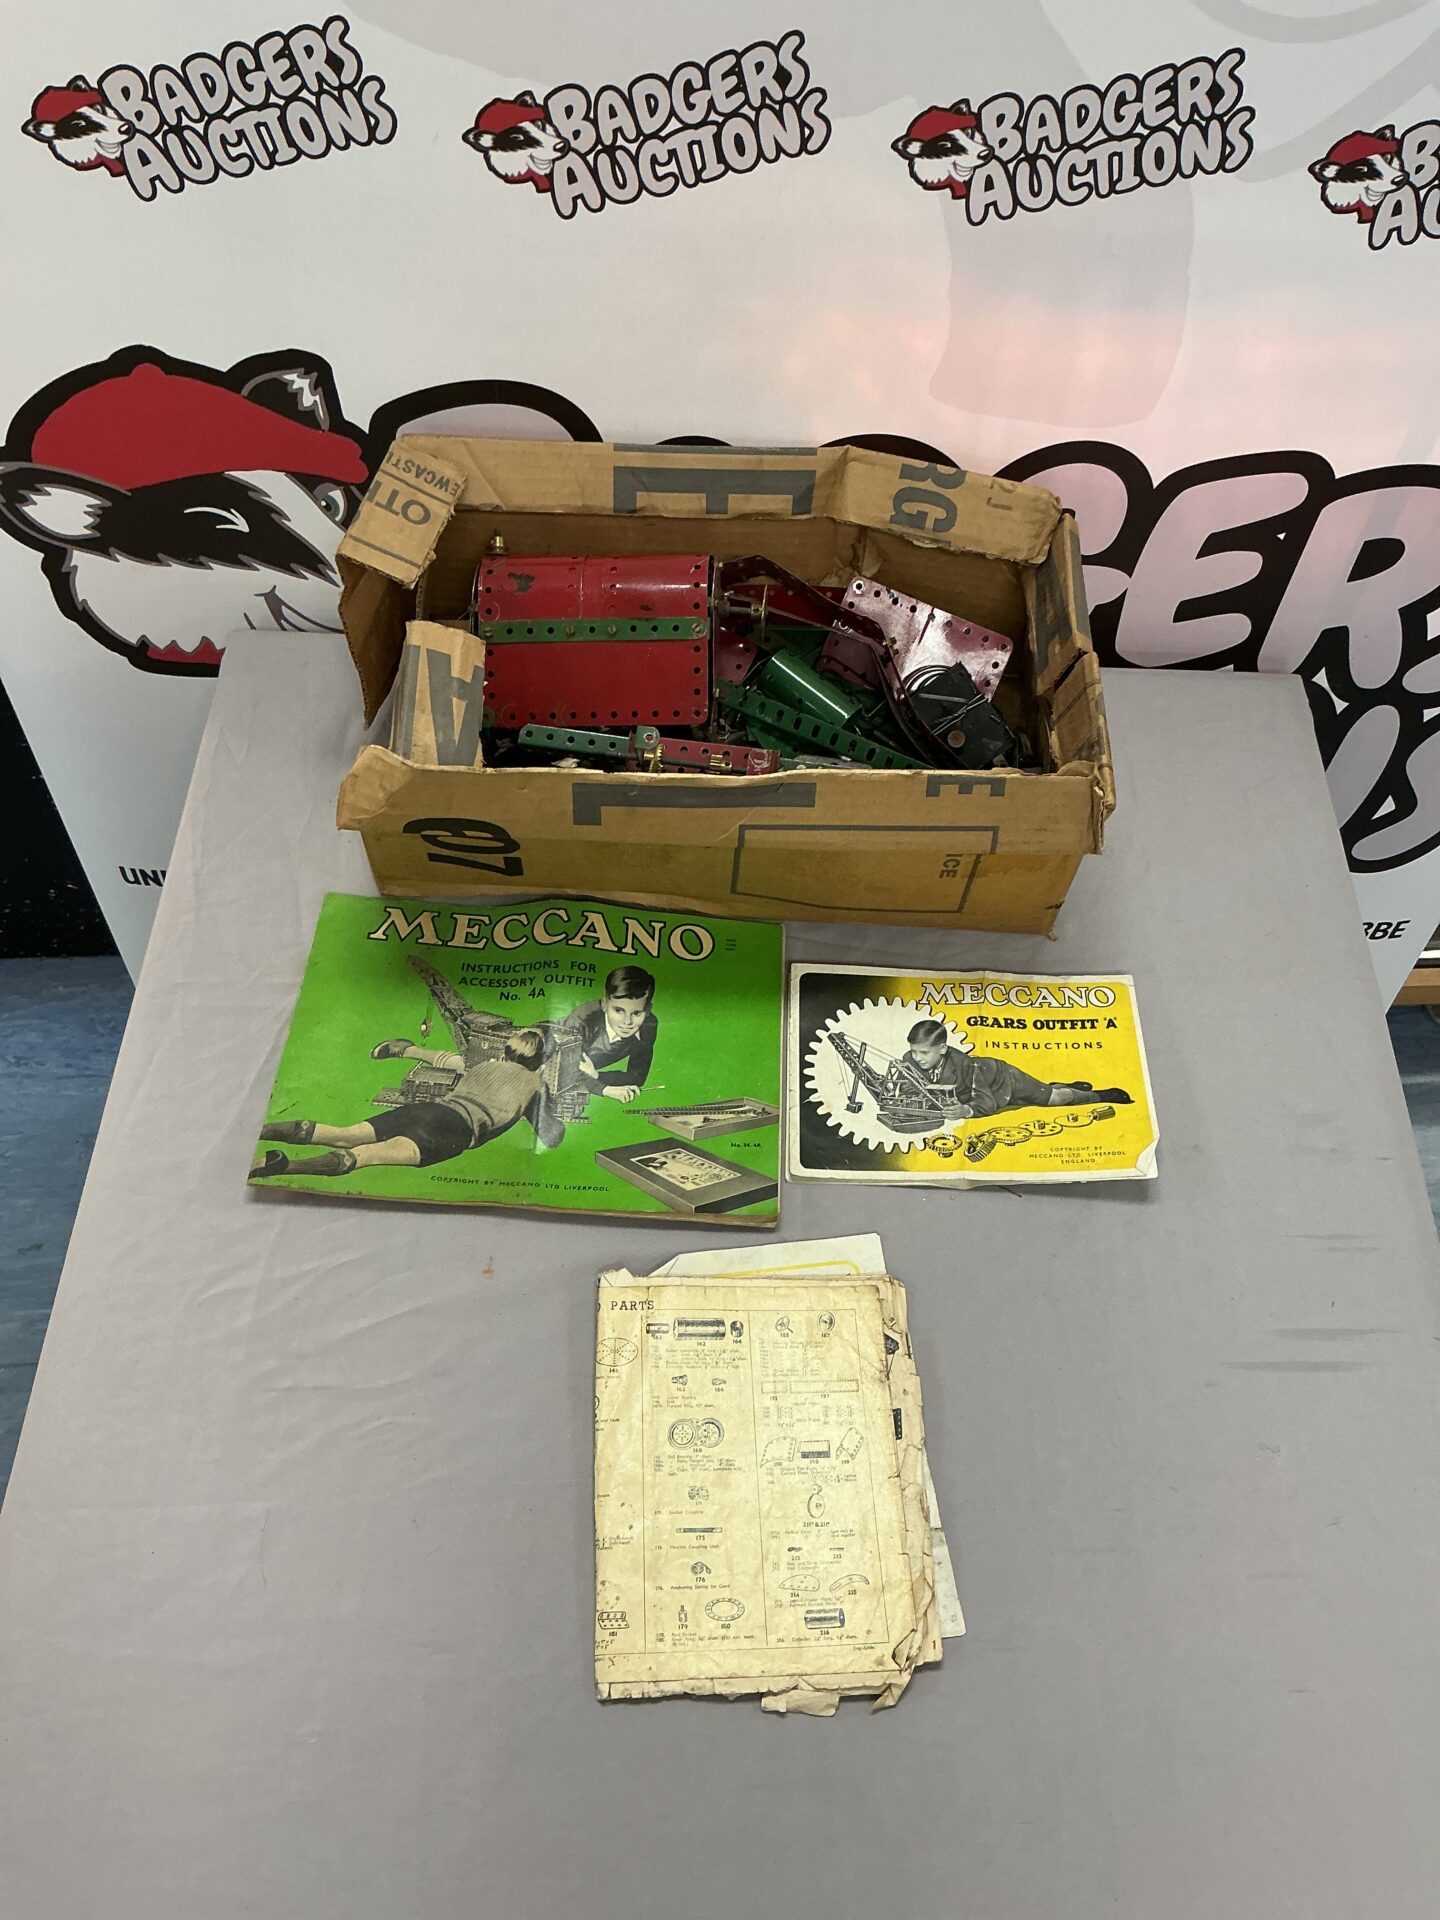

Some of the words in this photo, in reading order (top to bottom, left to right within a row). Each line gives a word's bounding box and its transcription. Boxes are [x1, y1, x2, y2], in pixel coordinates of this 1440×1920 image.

[97, 15, 363, 137] BADGERS
[544, 30, 810, 156] BADGERS
[978, 47, 1246, 163] BADGERS
[121, 75, 397, 202] AUCTIONS
[550, 87, 832, 220] AUCTIONS
[965, 105, 1256, 226] AUCTIONS
[367, 905, 715, 961] MECCANO
[461, 959, 560, 974] INSTRUCTIONS
[570, 961, 597, 973] FOR
[458, 976, 536, 988] ACCESSORY
[544, 974, 596, 988] OUTFIT
[499, 991, 521, 1000] No.
[528, 987, 545, 999] 4A
[917, 982, 1116, 1009] MECCANO
[966, 1015, 1027, 1030] GEARS
[1033, 1018, 1098, 1030] OUTFIT
[985, 1040, 1103, 1050] INSTRUCTIONS
[430, 1175, 479, 1185] COPYRIGHT
[611, 1300, 655, 1311] PARTS
